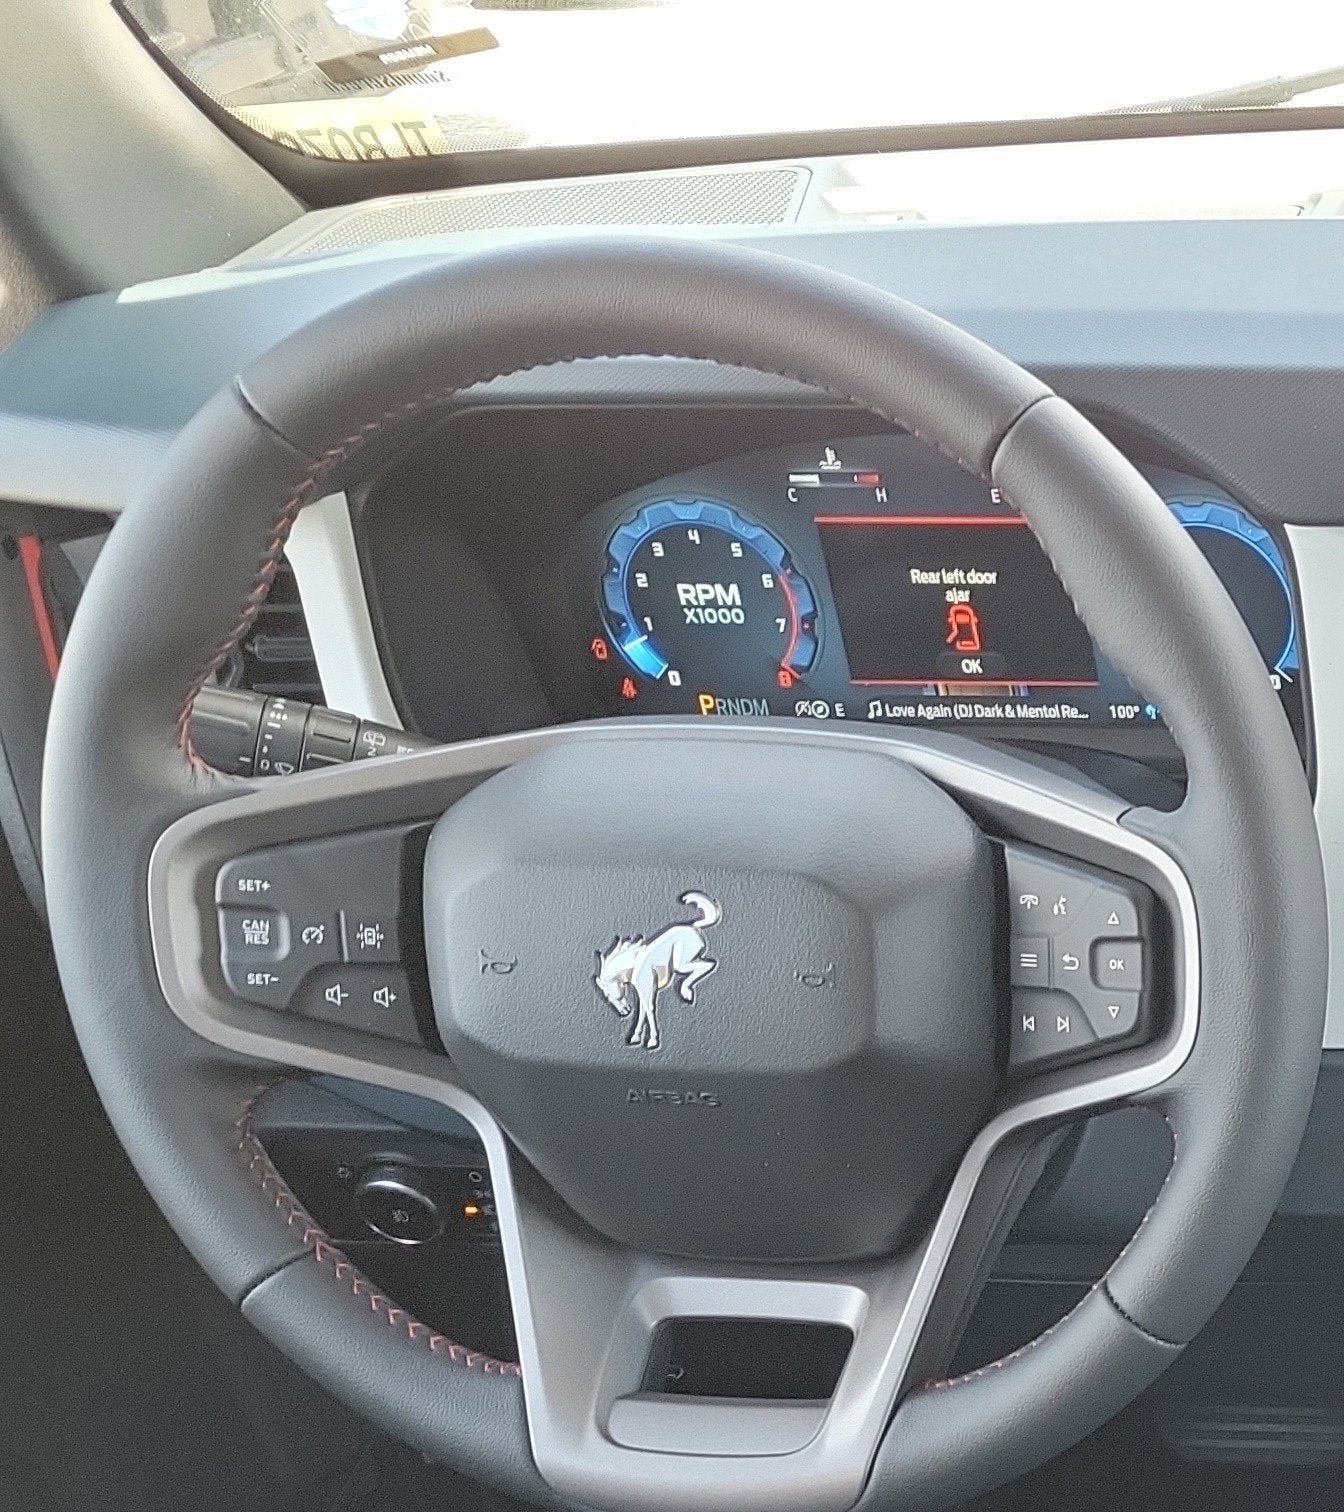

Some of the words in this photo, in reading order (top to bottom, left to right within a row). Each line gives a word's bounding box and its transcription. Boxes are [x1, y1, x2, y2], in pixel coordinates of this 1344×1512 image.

[788, 488, 798, 502] C
[876, 488, 887, 503] H
[688, 529, 700, 544] 4
[652, 542, 664, 557] 3
[731, 543, 743, 557] 5
[635, 573, 648, 588] 2
[762, 574, 774, 588] 6
[910, 569, 939, 584] Rear
[942, 569, 965, 584] left
[967, 569, 997, 585] door
[676, 583, 742, 606] RPM
[945, 589, 970, 604] ajar
[644, 617, 653, 631] 1
[775, 618, 786, 632] 7
[962, 659, 983, 674] OK
[668, 670, 681, 686] 0
[777, 670, 793, 688] 8
[835, 703, 846, 717] E
[885, 704, 914, 718] Love
[917, 704, 951, 720] Again
[954, 704, 972, 720] (DJ
[974, 704, 1002, 719] Dark
[1005, 705, 1015, 718] &
[1018, 705, 1058, 719] Mentol
[239, 879, 271, 892] SET+
[242, 920, 269, 933] CAN
[244, 932, 270, 945] RES
[1109, 959, 1124, 971] OK
